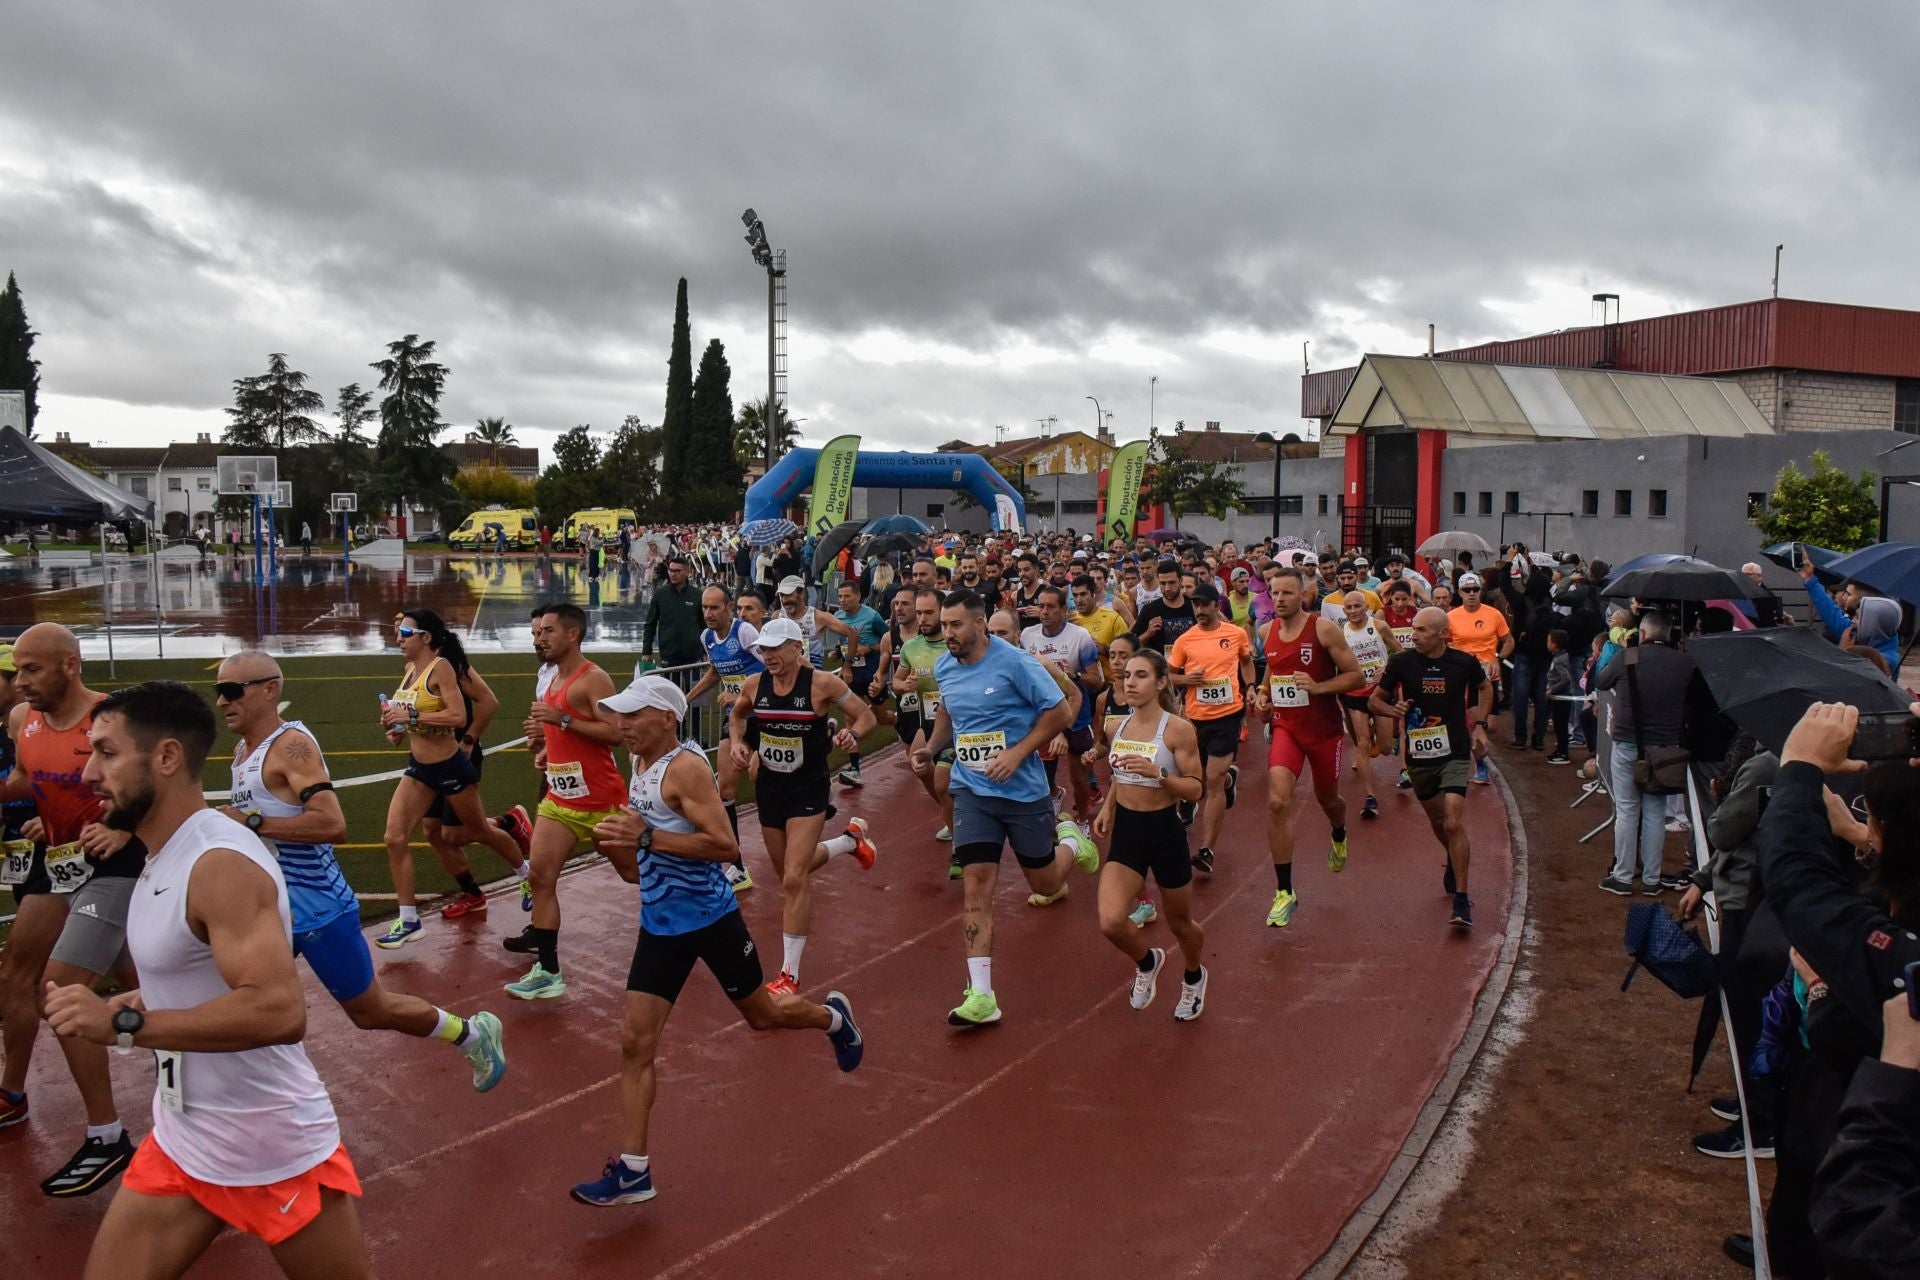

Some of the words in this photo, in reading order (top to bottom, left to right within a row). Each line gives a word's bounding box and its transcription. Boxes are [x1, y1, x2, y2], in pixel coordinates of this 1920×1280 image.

[898, 457, 909, 465] de
[912, 456, 945, 465] Santa
[949, 457, 962, 465] Fe
[838, 451, 853, 497] Granada
[826, 453, 843, 512] Diputación
[1120, 458, 1133, 515] Diputación
[836, 501, 844, 514] de
[1202, 686, 1226, 699] 581
[1278, 686, 1296, 698] 16
[1422, 685, 1446, 694] 2025
[1414, 737, 1443, 752] 606
[764, 747, 796, 763] 408
[552, 776, 579, 790] 192
